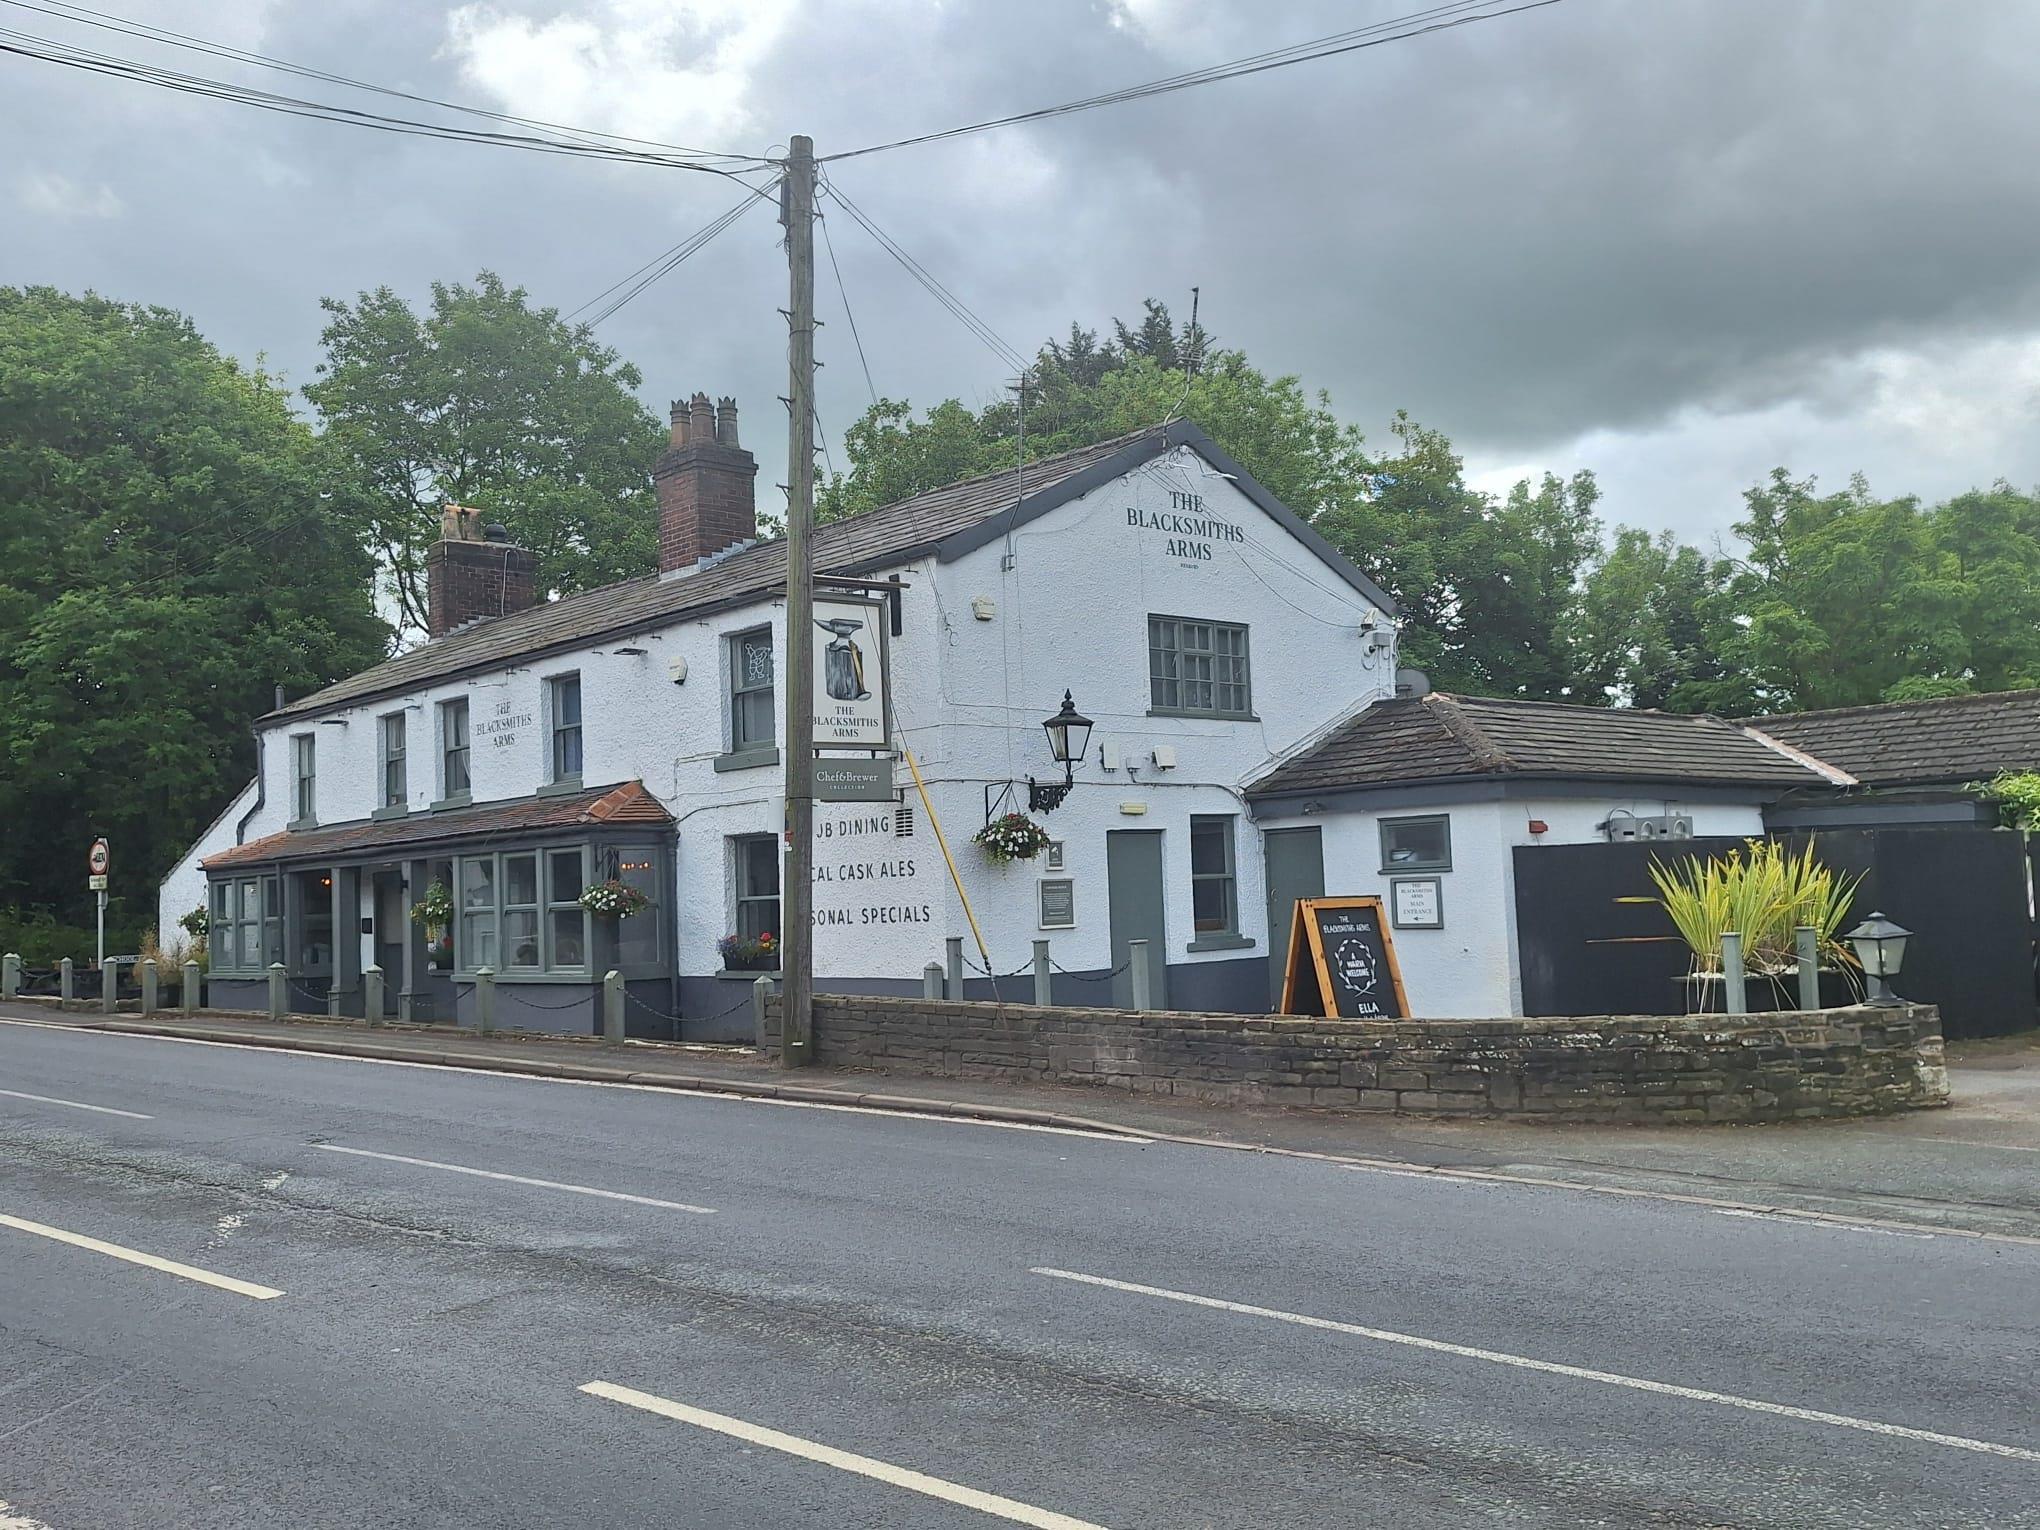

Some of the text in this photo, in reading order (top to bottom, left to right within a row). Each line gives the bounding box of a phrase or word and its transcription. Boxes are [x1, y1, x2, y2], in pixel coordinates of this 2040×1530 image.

[1169, 491, 1203, 512] THE
[1127, 508, 1244, 543] BLACKSMITHS
[1166, 538, 1212, 561] ARMS
[496, 701, 511, 715] THE
[835, 706, 855, 716] THE
[476, 713, 532, 735] BLACKSMITHS
[832, 729, 859, 737] ARMS
[493, 733, 515, 747] ARMS
[839, 816, 889, 836] DINING
[812, 860, 916, 882] CAL CASK ALES
[811, 905, 931, 926] SONAL SPECIALS
[1358, 1002, 1380, 1014] ELLA
